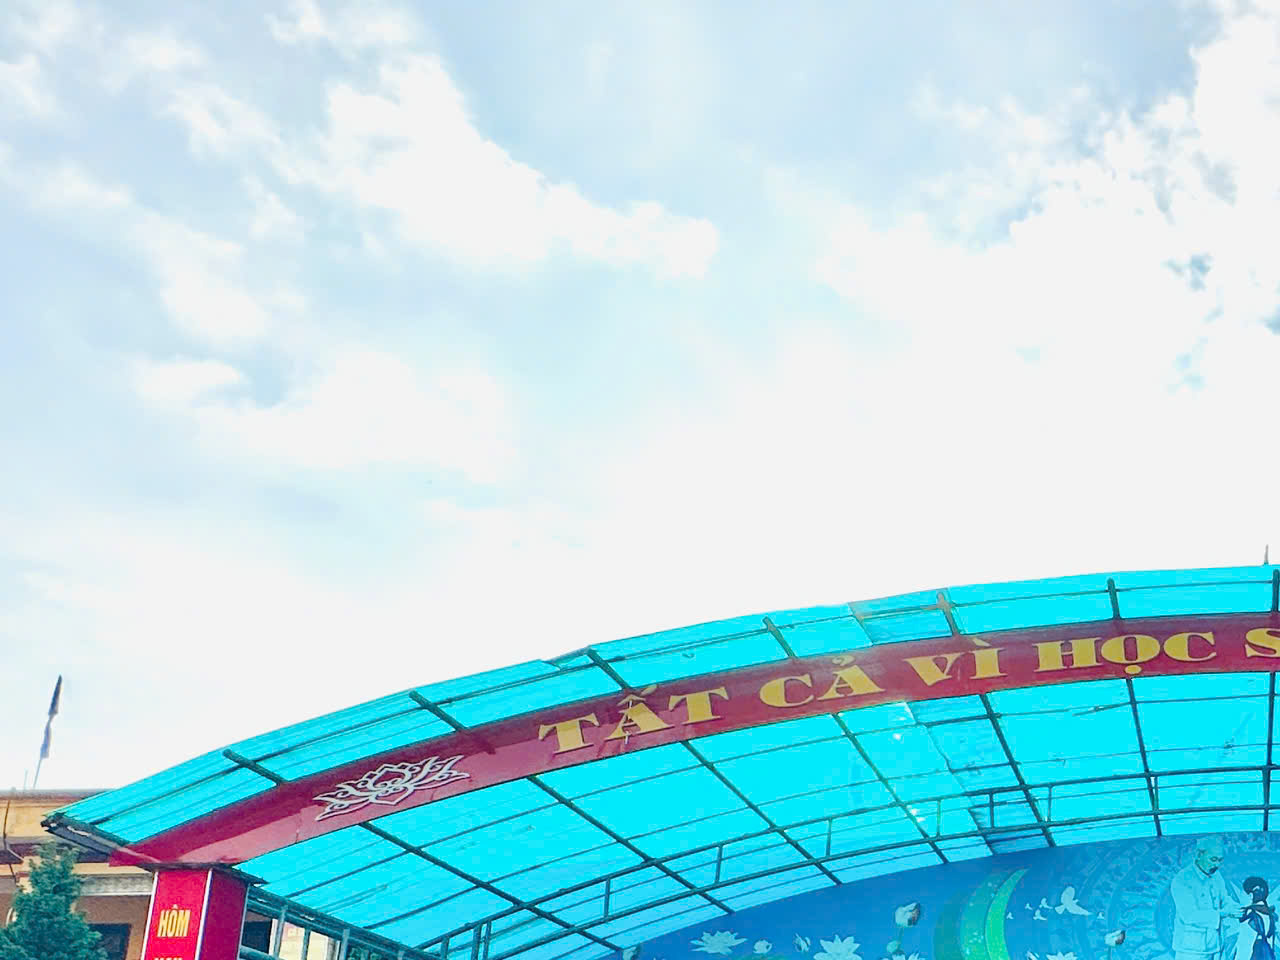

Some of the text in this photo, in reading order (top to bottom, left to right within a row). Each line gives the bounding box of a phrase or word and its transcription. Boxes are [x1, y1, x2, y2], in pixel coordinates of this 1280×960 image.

[539, 687, 728, 755] TẤT
[758, 653, 884, 709] CẢ
[906, 637, 1004, 688] VÌ
[1036, 632, 1217, 675] HỌC
[158, 905, 191, 938] HÔM
